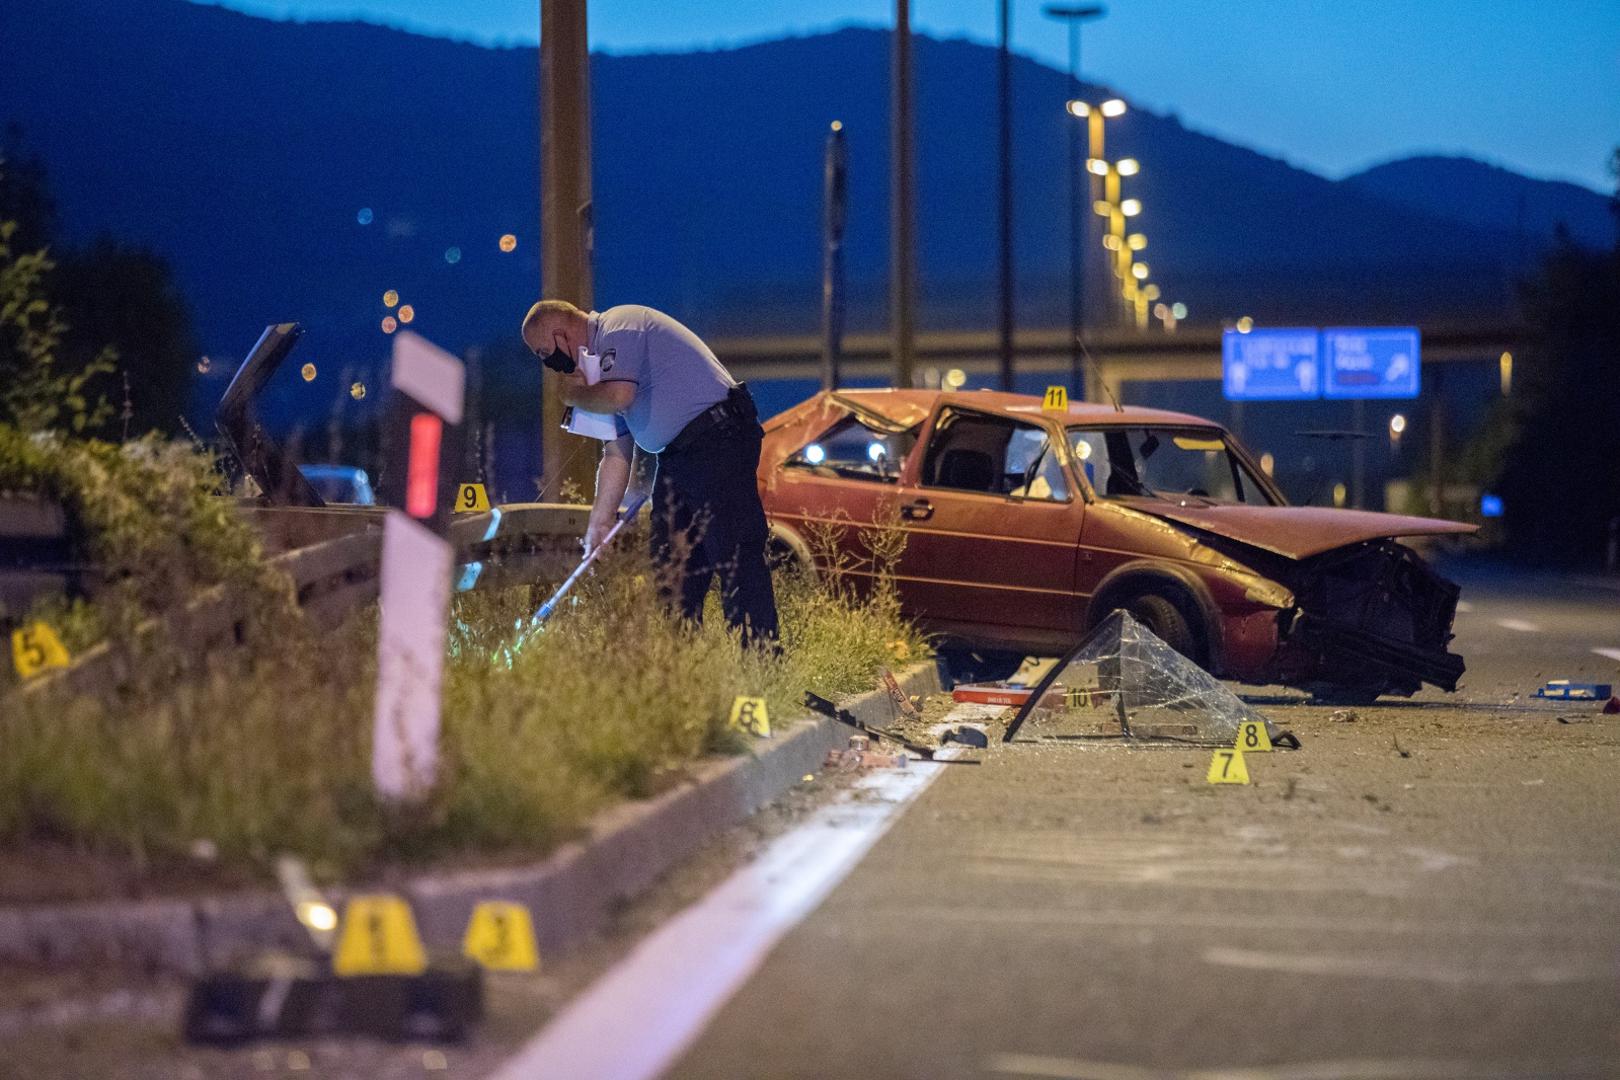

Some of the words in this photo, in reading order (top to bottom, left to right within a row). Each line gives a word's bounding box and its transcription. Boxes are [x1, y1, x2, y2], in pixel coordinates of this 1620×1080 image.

[1047, 389, 1063, 407] 11
[463, 486, 477, 508] 9
[23, 628, 46, 668] 5
[1071, 687, 1088, 708] 10
[1245, 724, 1259, 748] 8
[1219, 752, 1234, 779] 7
